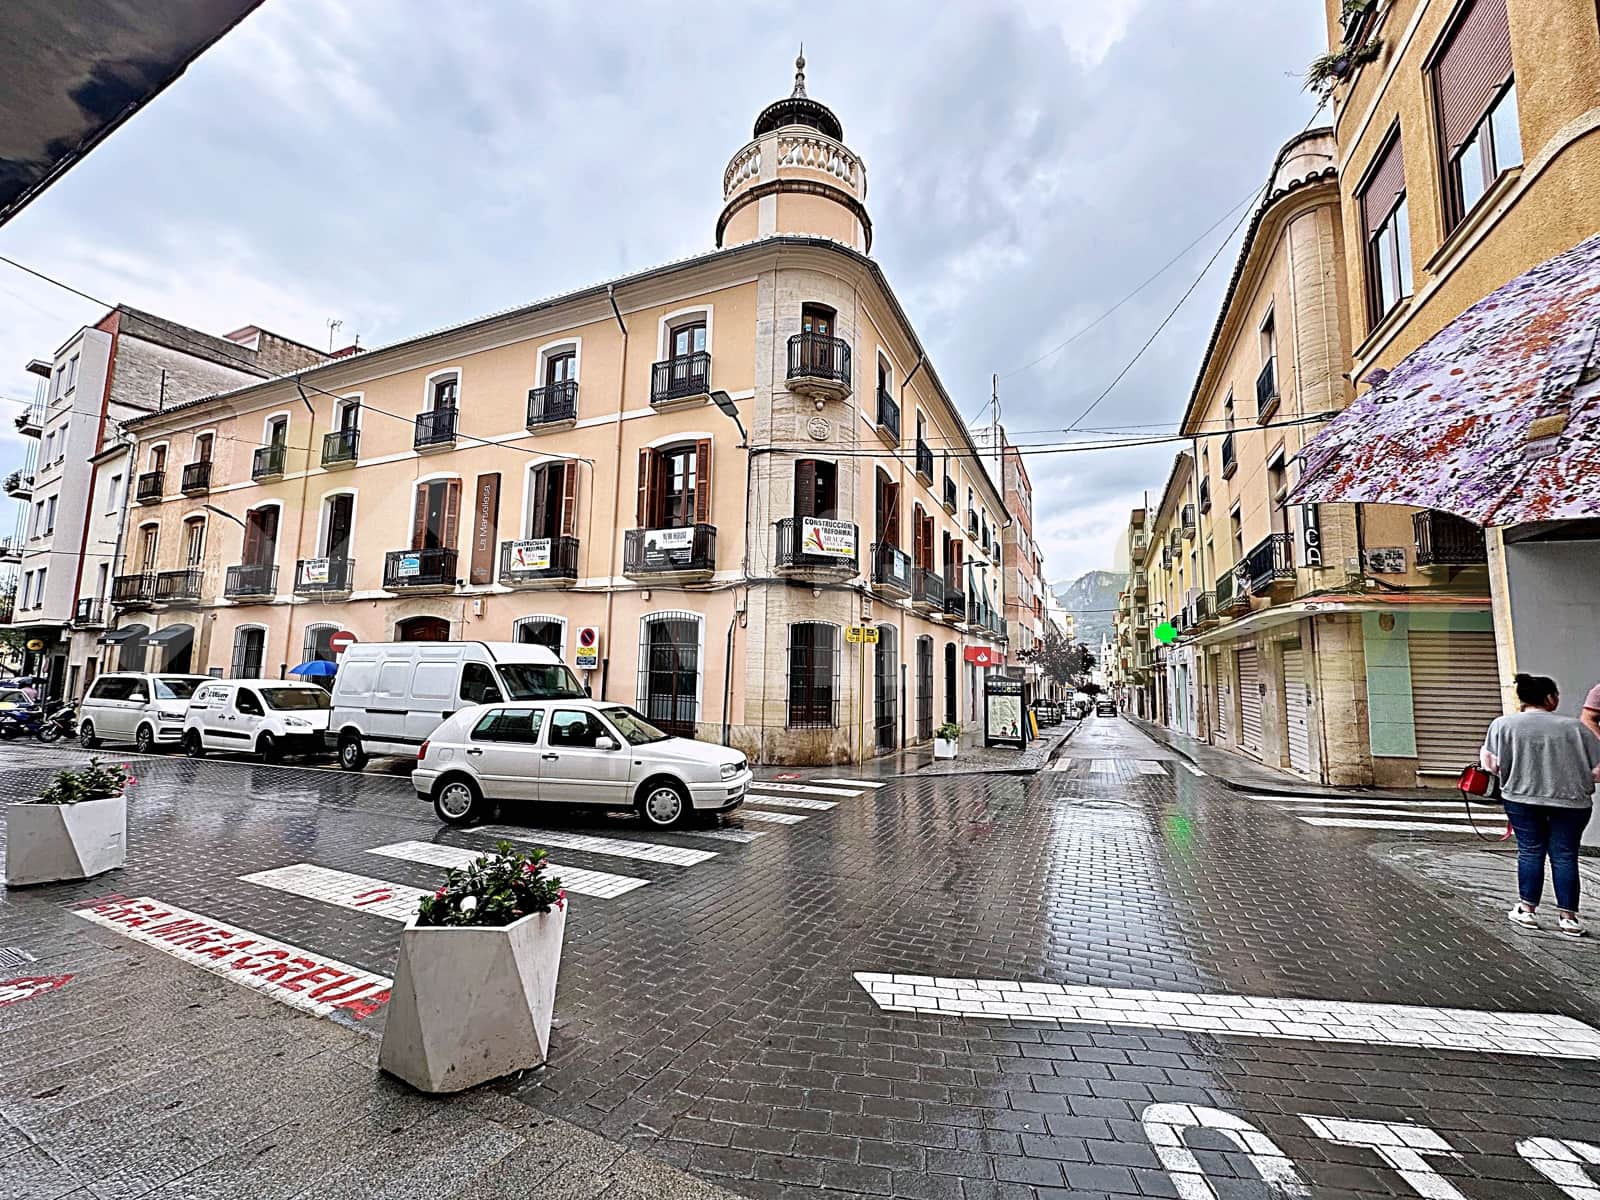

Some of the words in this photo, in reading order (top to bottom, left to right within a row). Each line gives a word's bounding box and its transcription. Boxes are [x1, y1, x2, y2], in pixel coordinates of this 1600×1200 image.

[1305, 504, 1322, 566] ICA
[141, 917, 256, 960] MIRA
[230, 948, 392, 1019] CREUA
